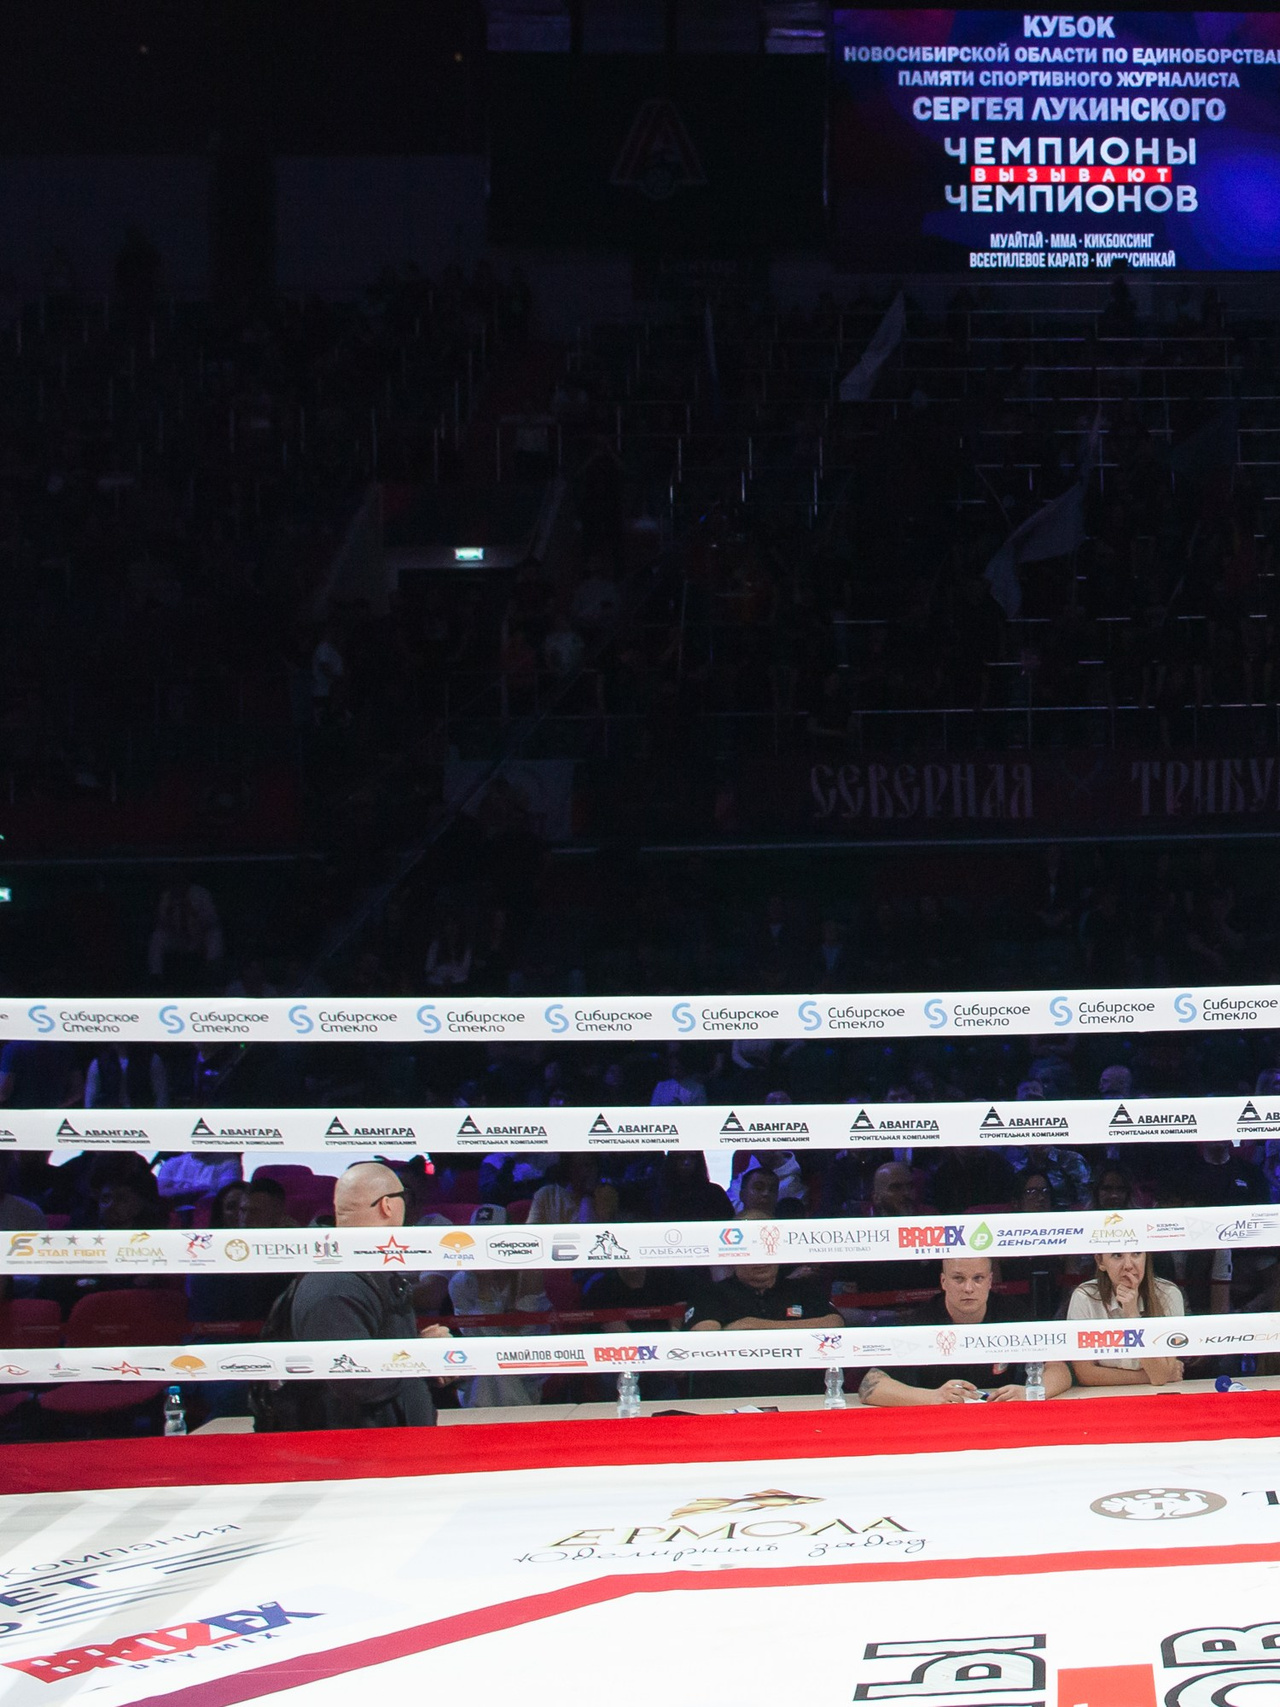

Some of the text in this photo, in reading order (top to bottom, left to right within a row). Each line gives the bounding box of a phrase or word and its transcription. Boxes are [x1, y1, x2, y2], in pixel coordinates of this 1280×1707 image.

[1023, 15, 1115, 39] КУБОК
[844, 43, 1011, 63] НОВОСИБИРСКОЙ
[1014, 47, 1098, 64] ОБЛАСТИ
[1102, 47, 1129, 64] ПО
[898, 70, 1240, 88] ПАМЯТИ СПОРТИВНОГО ЖУРНАЛИСТА
[912, 96, 1227, 121] СЕРГЕЯ ЛУКИНСКОГО
[944, 137, 1197, 165] ЧЕМПИОНЫ
[974, 168, 1169, 182] ВЫЗЫВАЮТ
[944, 184, 1199, 212] ЧЕМПИОНОВ
[990, 231, 1154, 248] МУАЙТАЙ ММА КИКБОКСИНГ
[969, 252, 1046, 268] ВСЕСТИЛЕВОЕ
[1048, 252, 1089, 268] КАРАТЭ
[953, 1003, 1031, 1017] Сибирское
[1078, 1001, 1156, 1015] Сибирское
[1202, 997, 1279, 1012] Сибирское
[447, 1011, 525, 1024] Сибирское
[574, 1010, 653, 1022] Сибирское
[701, 1008, 780, 1021] Сибирское
[827, 1006, 906, 1019] Сибирское
[1078, 1013, 1134, 1025] Стекло
[1202, 1010, 1258, 1022] Стекло
[448, 1022, 505, 1033] Стекло
[576, 1021, 633, 1032] Стекло
[702, 1020, 759, 1031] Стекло
[828, 1018, 885, 1029] Стекло
[954, 1016, 1010, 1028] Стекло
[878, 1119, 940, 1131] АВАНГАРД
[1008, 1116, 1069, 1128] АВАНГАРД
[1137, 1113, 1198, 1125] АВАНГАРД
[353, 1127, 416, 1138] АВАНГАРД
[485, 1125, 548, 1136] АВАНГАРД
[617, 1124, 679, 1135] АВАНГАРД
[748, 1121, 810, 1133] АВАНГАРД
[788, 1229, 890, 1245] РАКОВАРНЯ
[898, 1225, 966, 1248] BROZEX
[996, 1228, 1084, 1238] ЗАПРАВЛЯЕМ
[489, 1239, 540, 1250] сибирский
[997, 1238, 1068, 1247] ДЕНЬГАМИ
[252, 1243, 308, 1256] ТЕРКИ
[964, 1332, 1068, 1348] РАКОВАРНЯ
[1077, 1329, 1146, 1349] BROZEX
[496, 1349, 586, 1361] САМОЙЛОВ ФОНД
[594, 1345, 660, 1362] BROZEX
[691, 1347, 803, 1359] FIGHTEXPERT
[547, 1515, 915, 1547] ЕРМОЛА
[1, 1600, 326, 1684] BROZEX
[128, 1632, 280, 1670] DRY MIX
